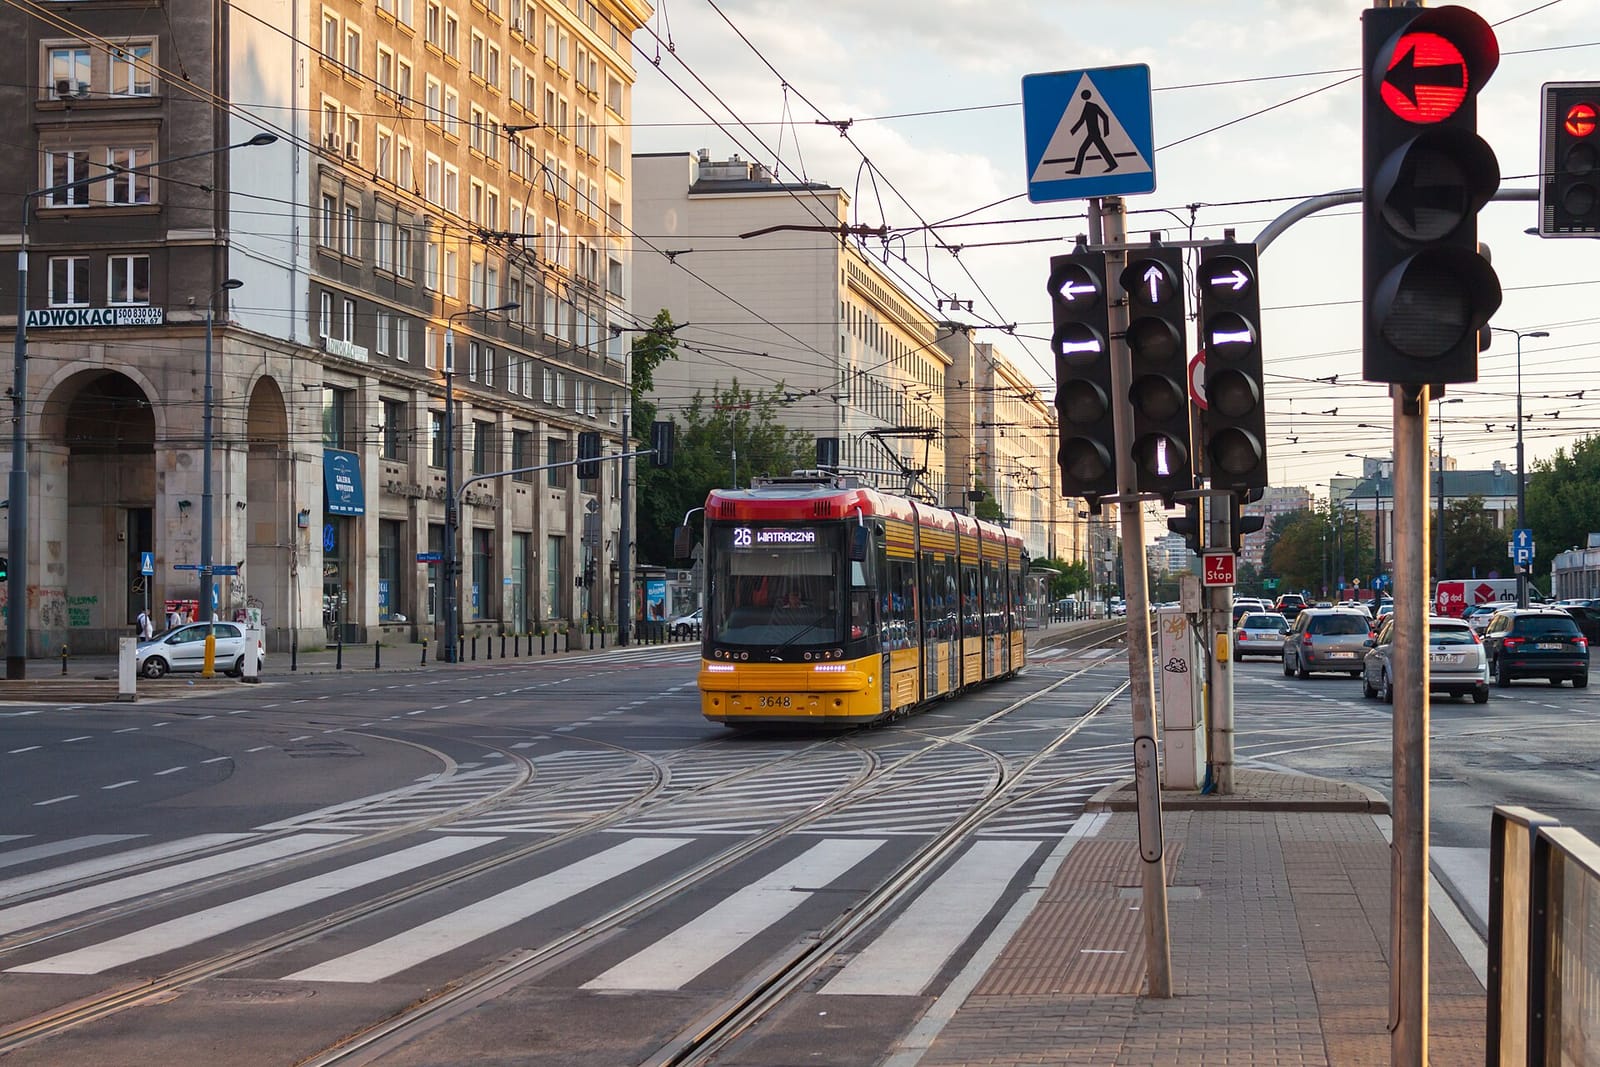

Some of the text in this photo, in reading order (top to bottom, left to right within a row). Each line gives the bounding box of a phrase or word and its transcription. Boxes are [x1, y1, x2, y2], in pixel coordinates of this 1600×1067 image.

[27, 310, 117, 326] ADWOKACI
[118, 308, 162, 319] 500 830 026
[734, 528, 815, 545] 26 WIATRACZNA
[1518, 549, 1529, 563] P
[1215, 557, 1224, 570] Z
[1207, 571, 1232, 582] Stop
[1450, 594, 1462, 602] dpd
[1500, 589, 1518, 601] dp
[760, 696, 791, 708] 3648
